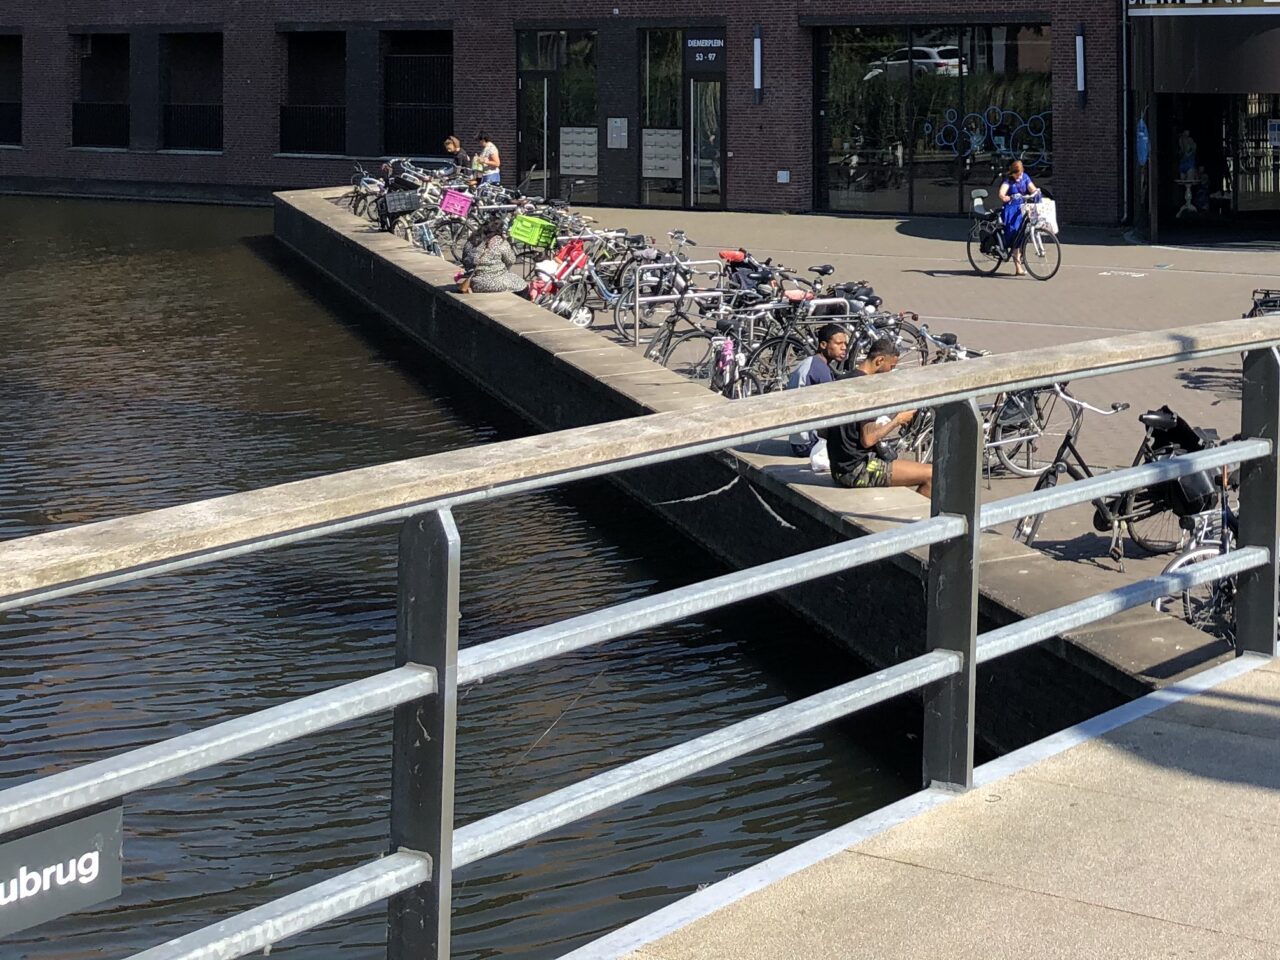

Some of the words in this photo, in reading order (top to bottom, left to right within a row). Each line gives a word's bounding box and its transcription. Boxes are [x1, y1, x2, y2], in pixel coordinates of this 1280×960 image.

[687, 39, 725, 48] DIEMERPLEIN
[695, 53, 703, 61] 53
[708, 53, 716, 61] 97
[0, 850, 100, 906] ubrug
